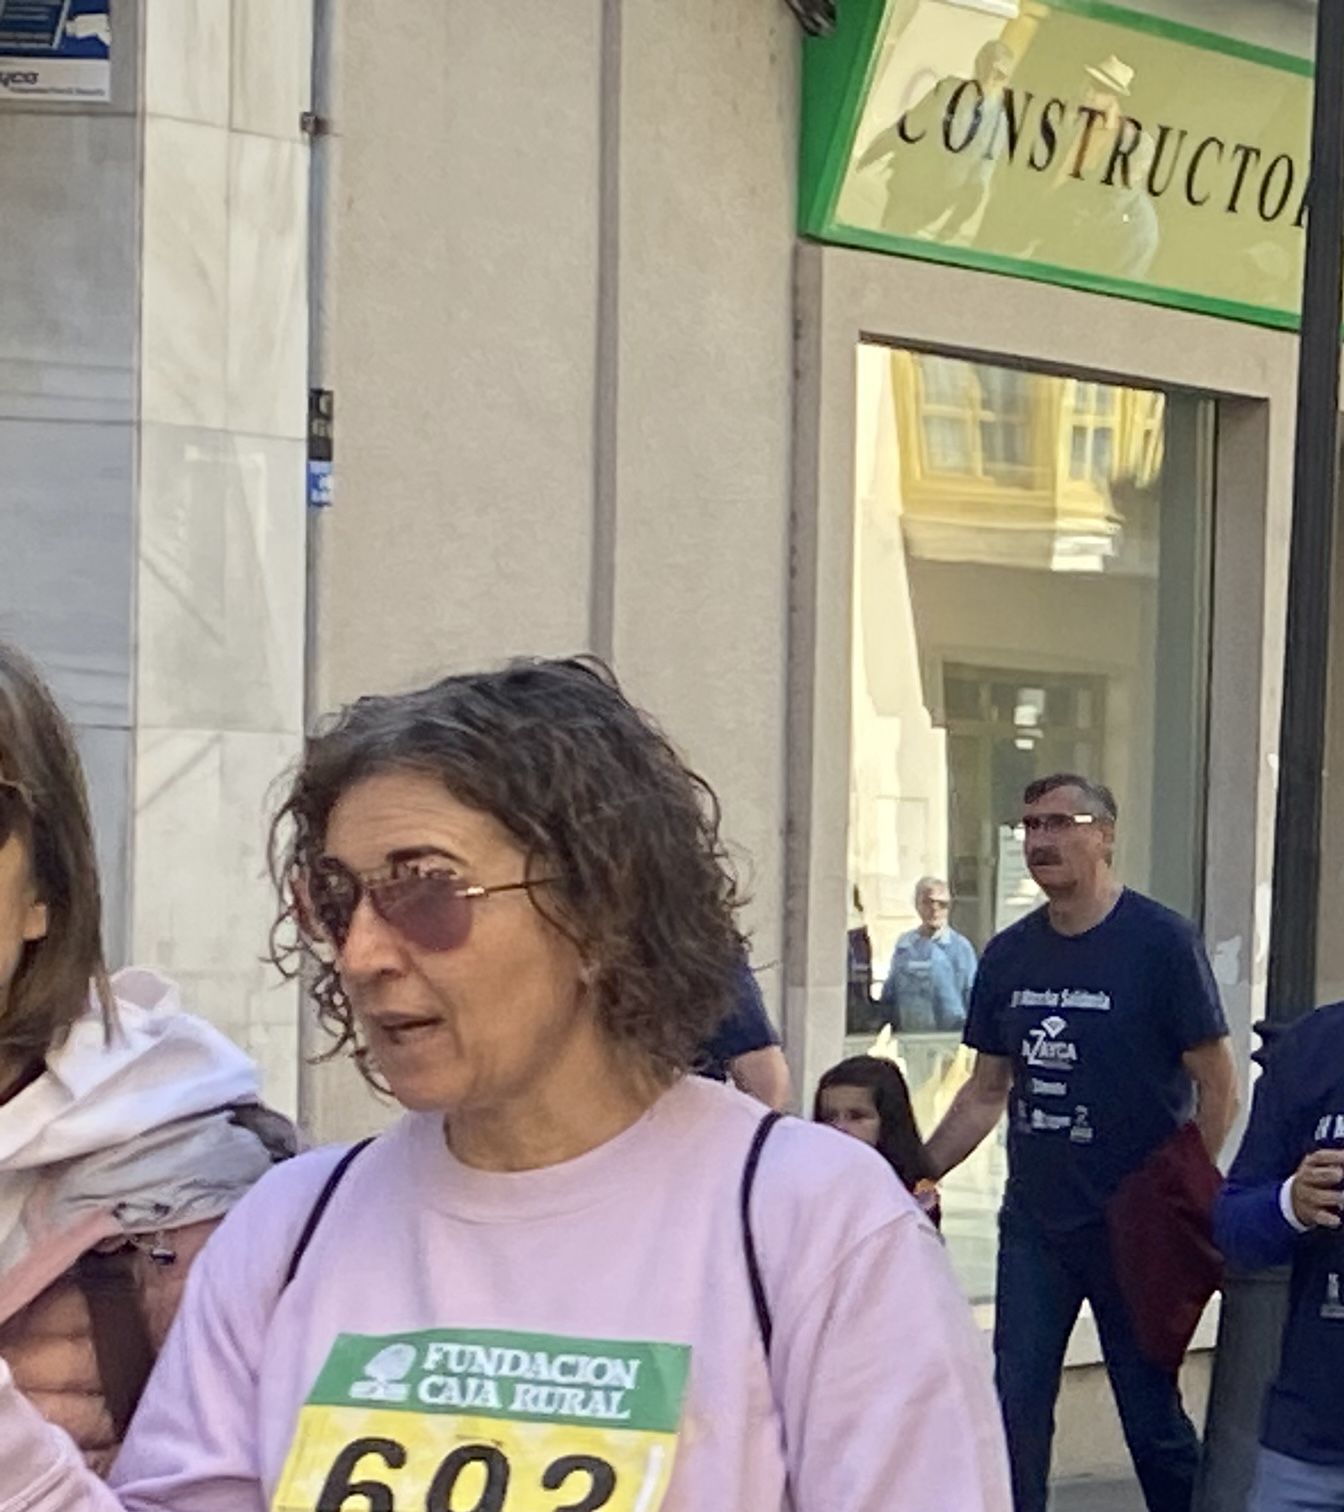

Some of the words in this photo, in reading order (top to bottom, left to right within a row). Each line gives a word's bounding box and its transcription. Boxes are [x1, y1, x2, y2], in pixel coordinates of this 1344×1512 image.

[423, 1342, 641, 1390] FUNDACION
[417, 1376, 505, 1411] CAJA
[508, 1383, 632, 1420] RURAL
